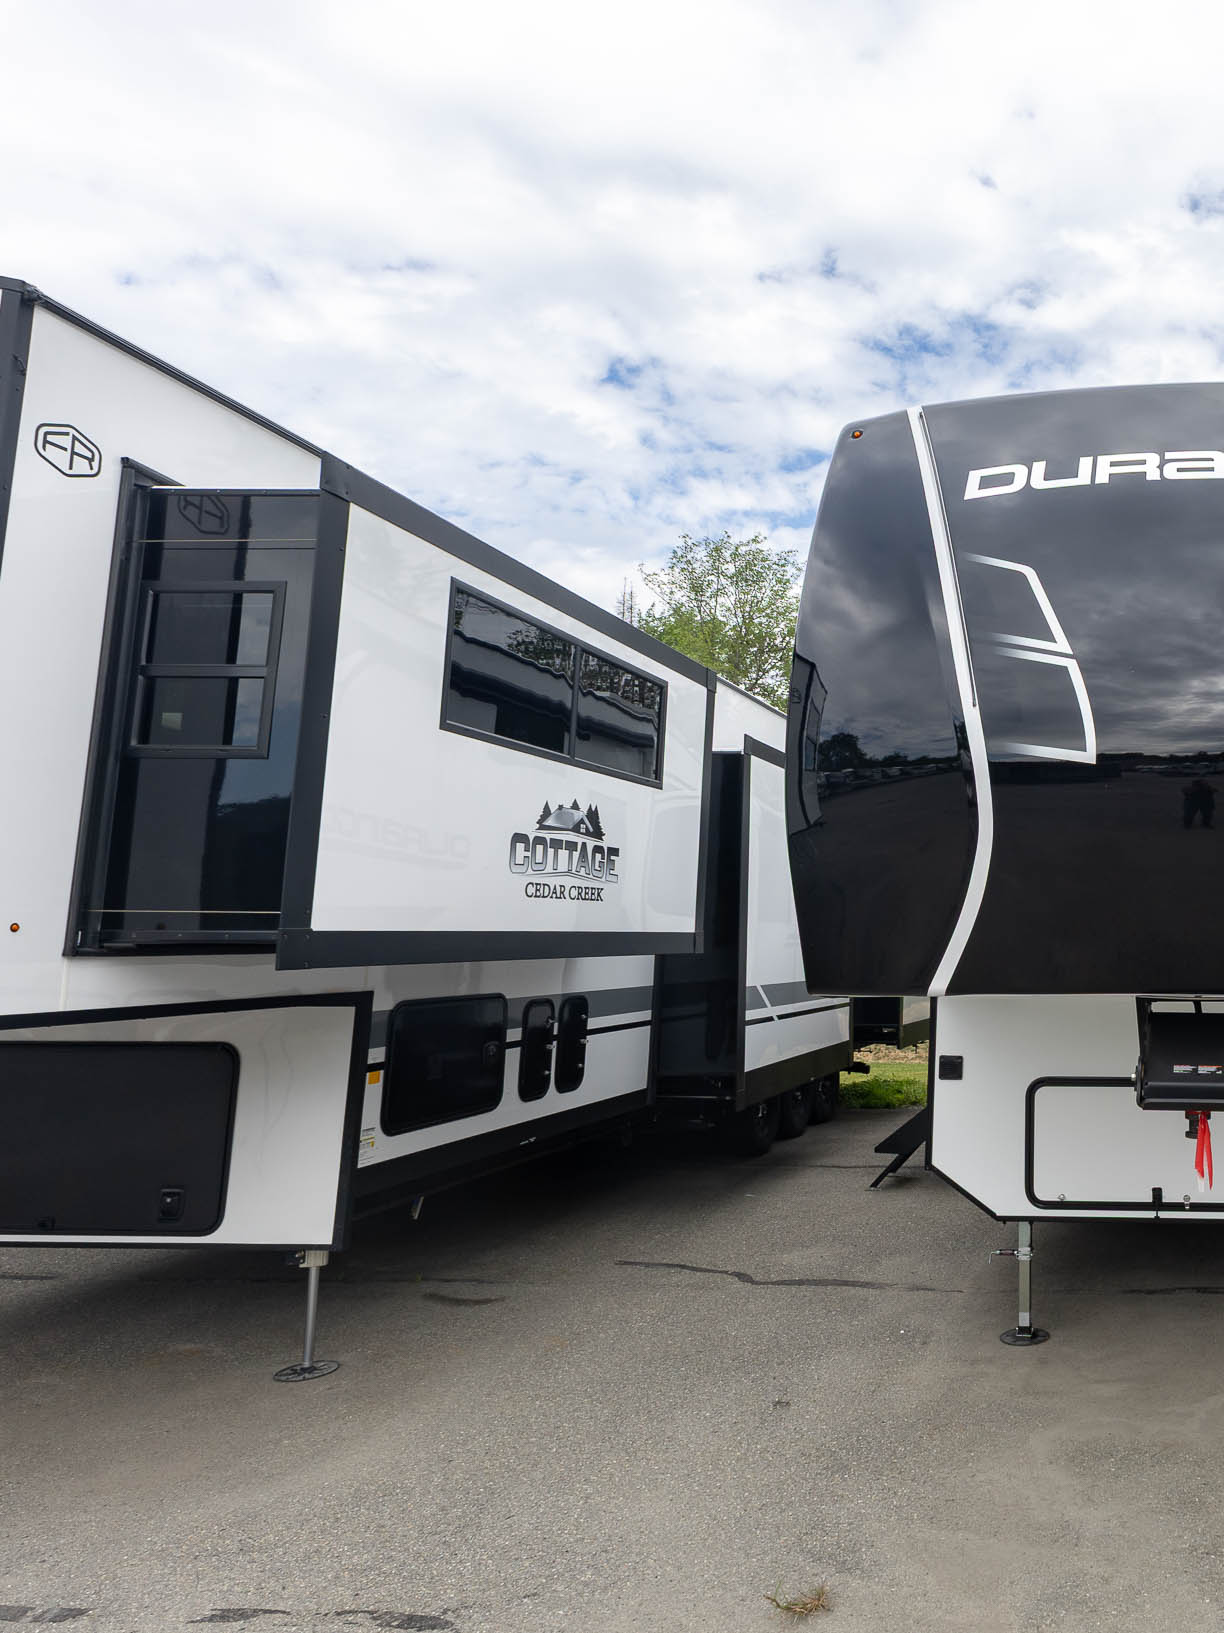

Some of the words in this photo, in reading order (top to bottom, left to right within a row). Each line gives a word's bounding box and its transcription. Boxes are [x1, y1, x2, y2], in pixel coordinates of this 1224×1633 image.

[42, 430, 95, 471] FR
[509, 832, 620, 883] COTTAGE
[525, 882, 566, 899] CEDAR
[569, 885, 604, 902] CREEK
